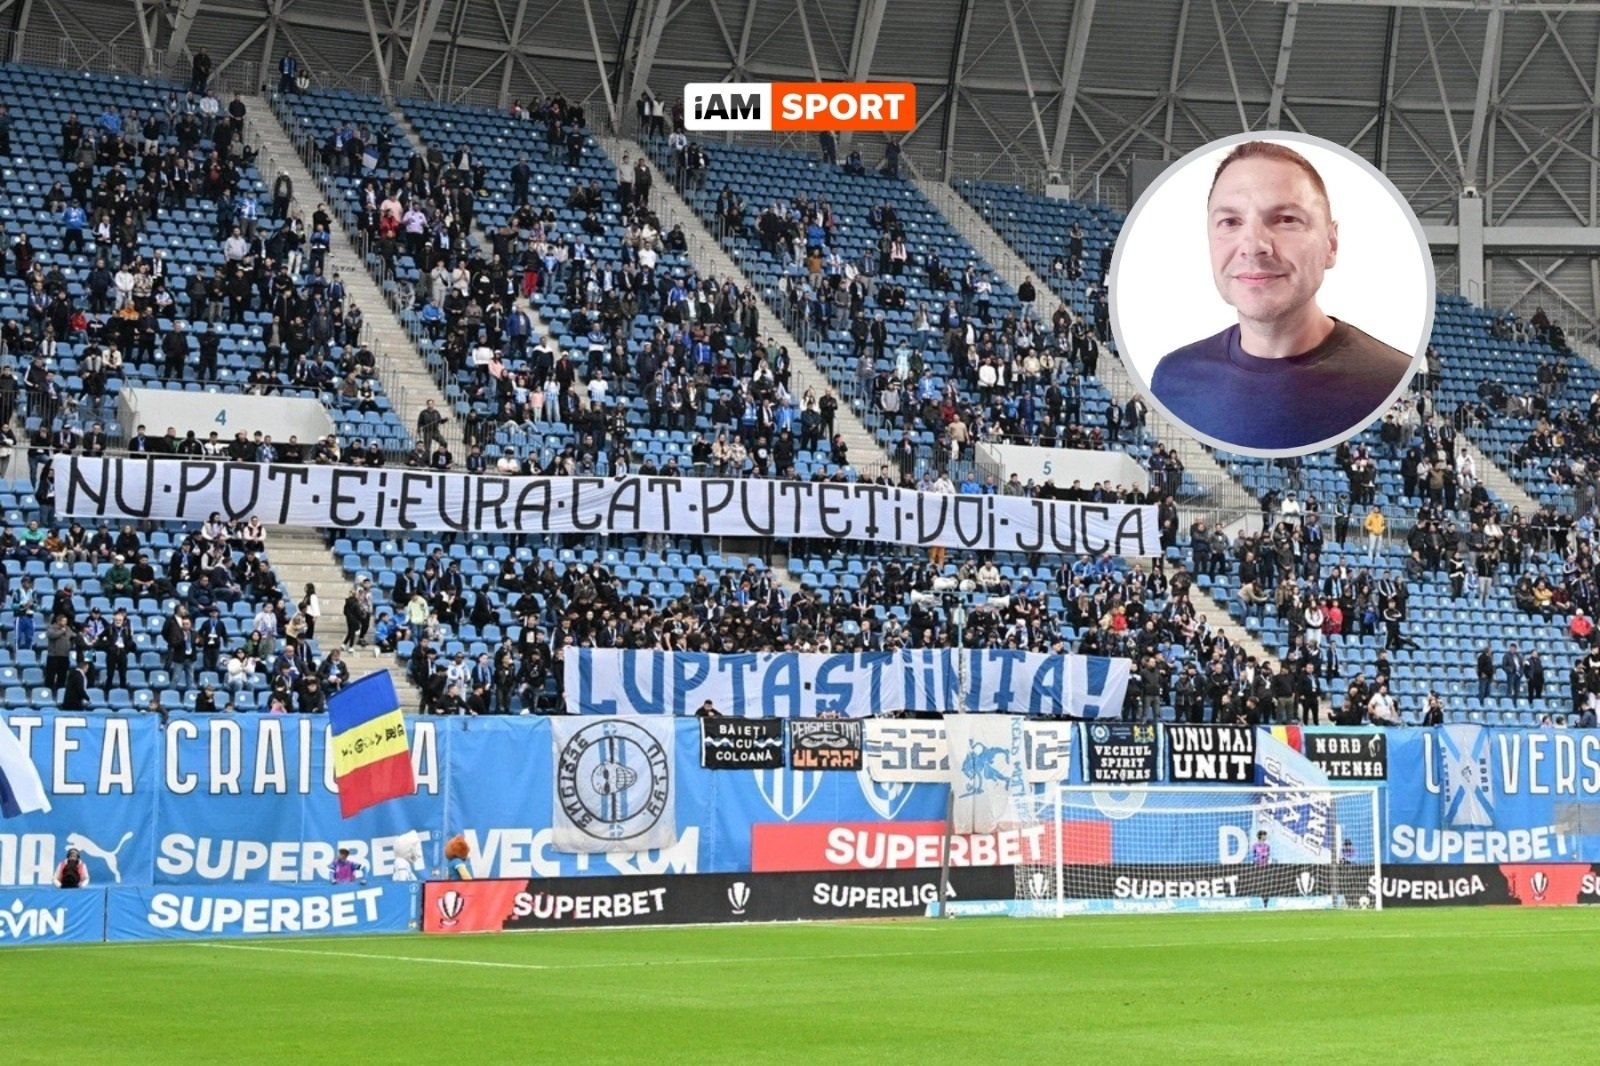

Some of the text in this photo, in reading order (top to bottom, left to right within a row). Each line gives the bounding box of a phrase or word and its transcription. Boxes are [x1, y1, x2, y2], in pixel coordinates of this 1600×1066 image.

[214, 409, 227, 426] 4
[1042, 461, 1052, 475] 5
[735, 739, 753, 749] CU
[1094, 745, 1152, 757] VECHIUL
[1170, 727, 1253, 752] UNU MAI
[1315, 738, 1361, 754] NORD
[1100, 757, 1145, 768] SPIRIT
[1172, 753, 1252, 780] UNIT
[825, 825, 1045, 869] SUPERBET
[1391, 824, 1568, 864] SUPERBET
[812, 882, 957, 909] SUPERLIGA
[1113, 876, 1239, 898] SUPERBET
[1367, 874, 1486, 900] SUPERLIGA
[147, 886, 384, 933] SUPERBET
[513, 888, 666, 919] SUPERBET
